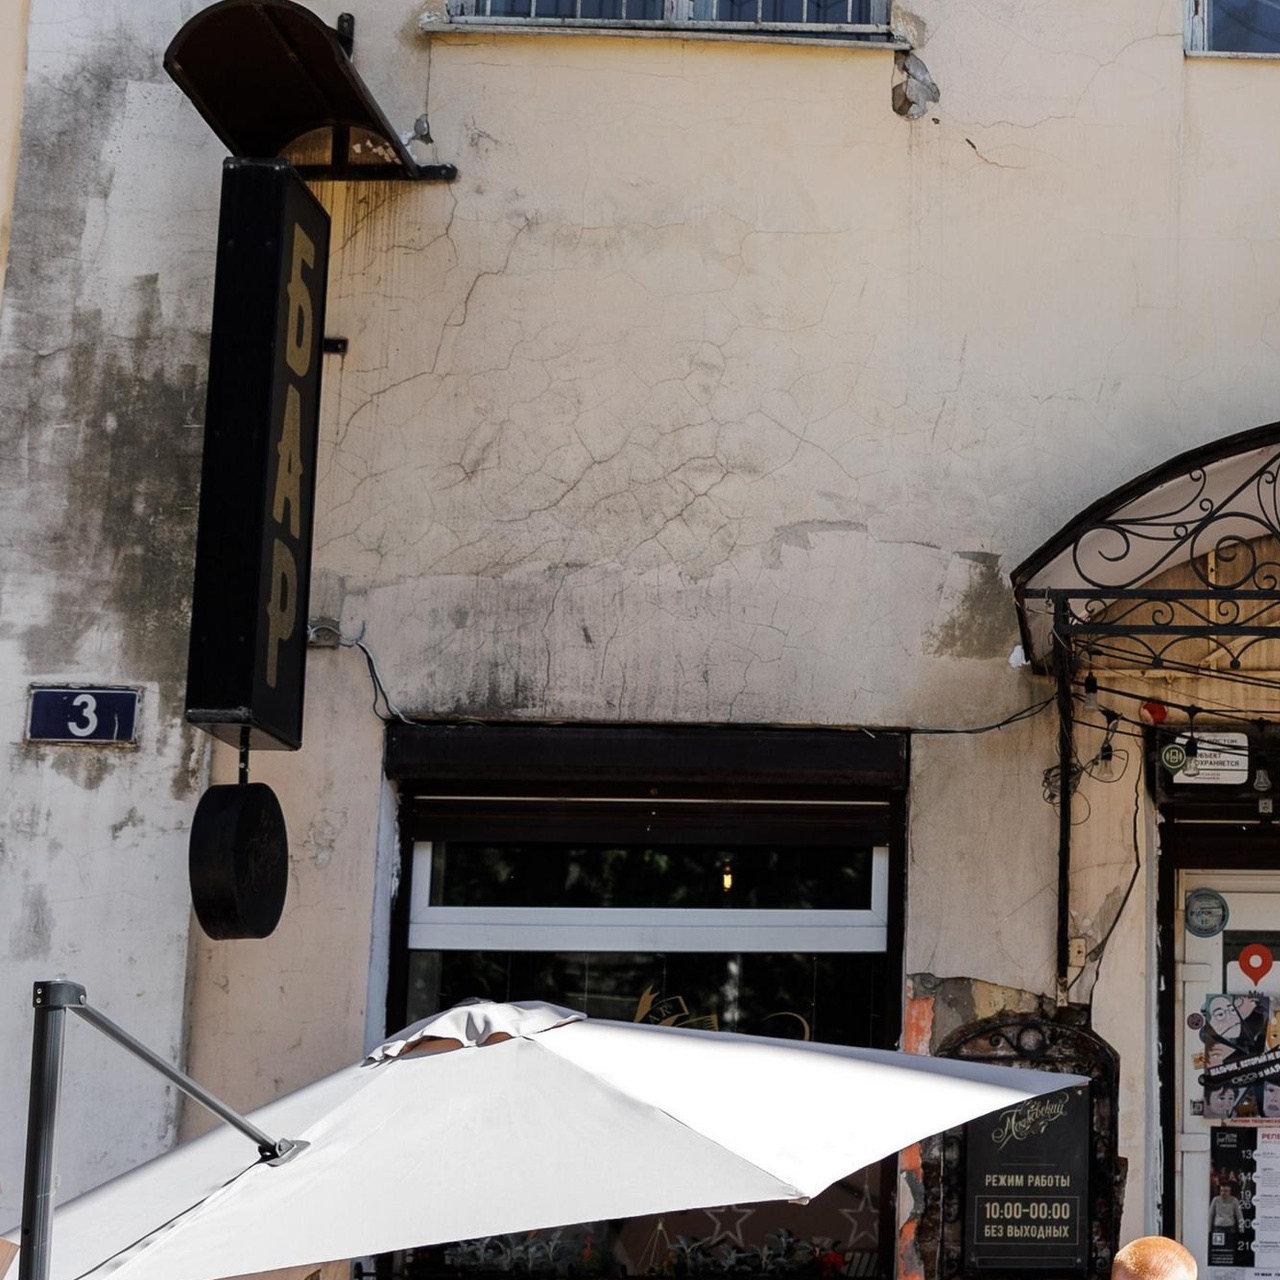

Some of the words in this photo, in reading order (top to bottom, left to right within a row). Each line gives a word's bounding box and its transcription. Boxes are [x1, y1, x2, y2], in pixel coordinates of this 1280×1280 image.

[265, 222, 315, 688] БАР
[67, 693, 98, 737] 3
[1241, 1149, 1253, 1160] 13
[985, 1174, 1024, 1187] РЕЖИМ
[1027, 1174, 1071, 1187] РАБОТЫ
[984, 1225, 1004, 1237] БЕЗ
[1007, 1225, 1070, 1239] ВЫХОДНЫХ
[1237, 1240, 1250, 1251] 21
